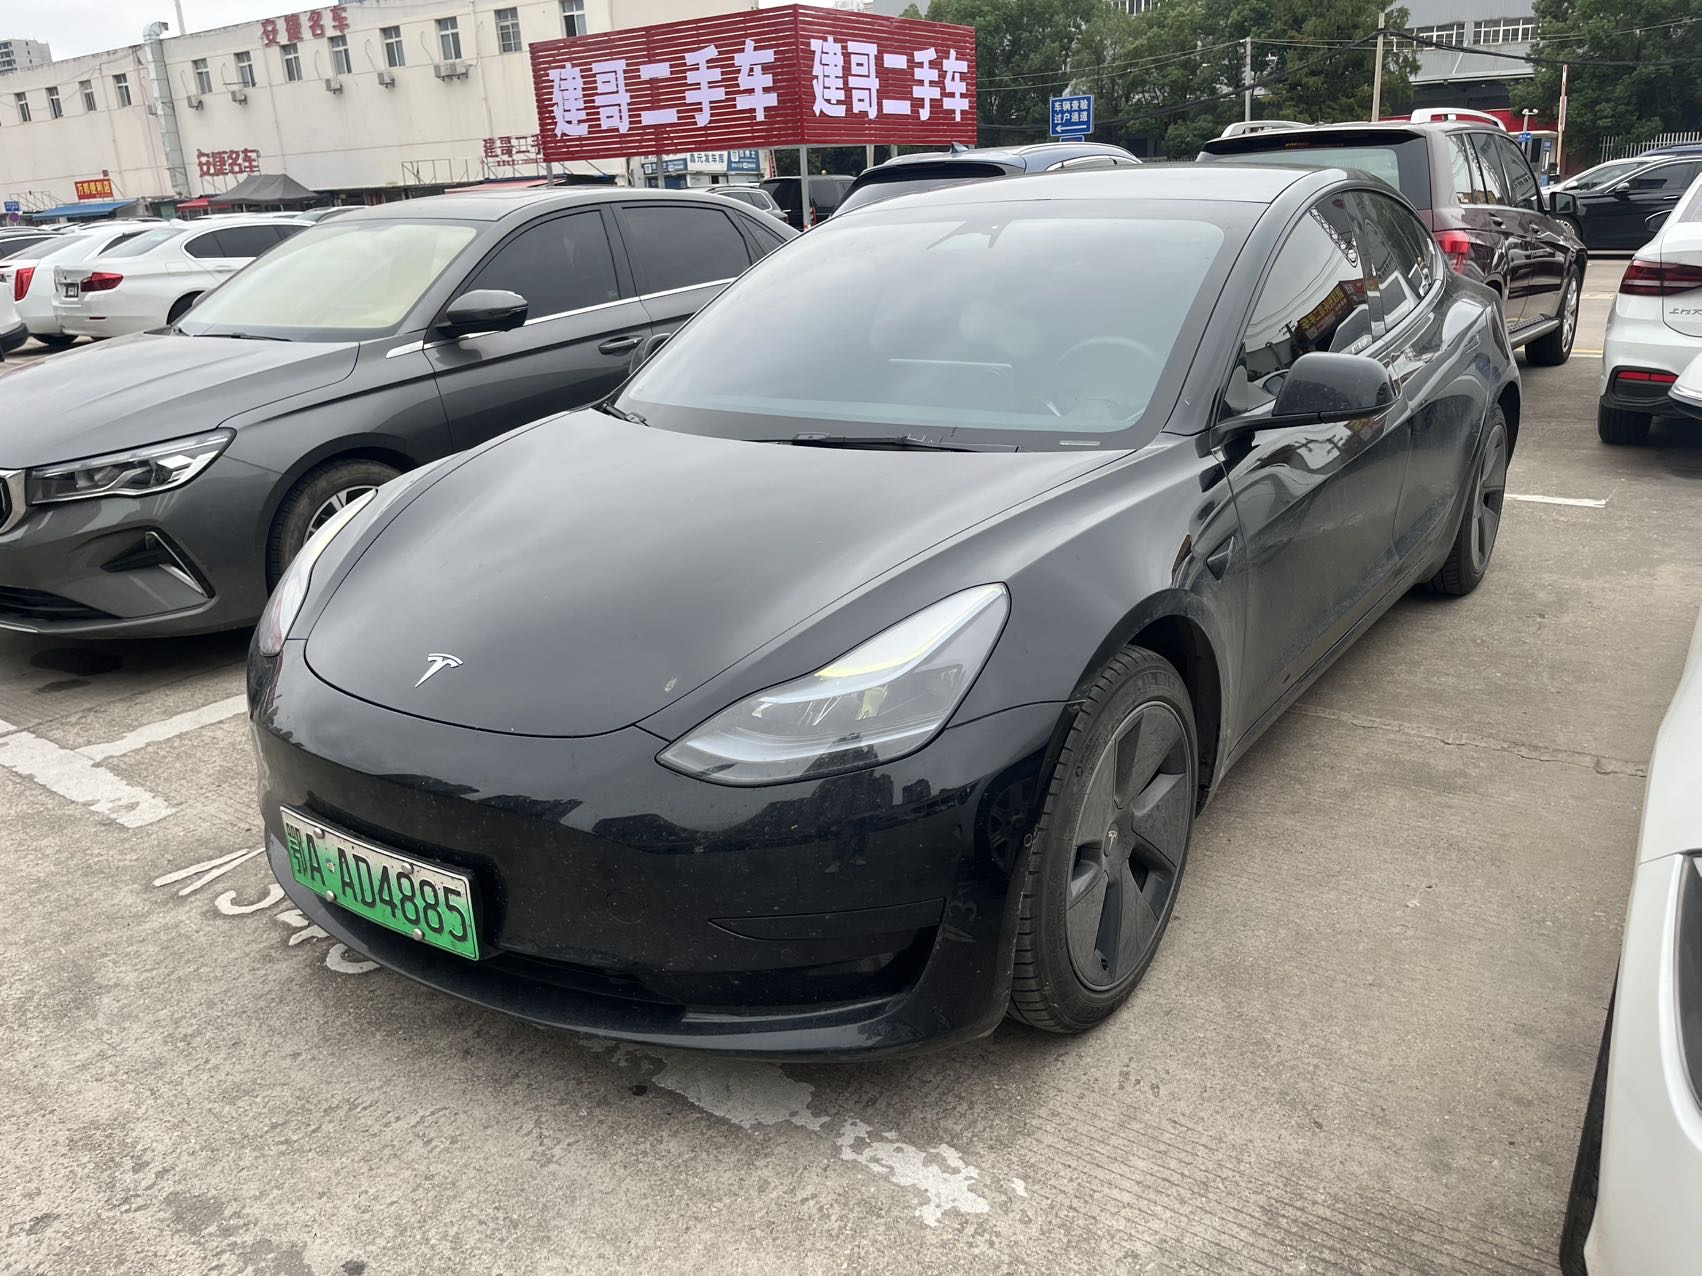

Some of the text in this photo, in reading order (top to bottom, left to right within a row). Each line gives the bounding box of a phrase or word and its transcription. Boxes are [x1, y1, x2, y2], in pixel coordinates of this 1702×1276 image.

[548, 38, 778, 139] 建哥二手车
[810, 36, 970, 122] 建哥二手车
[1054, 99, 1088, 111] 车辆查验
[1054, 111, 1088, 123] 过户通道
